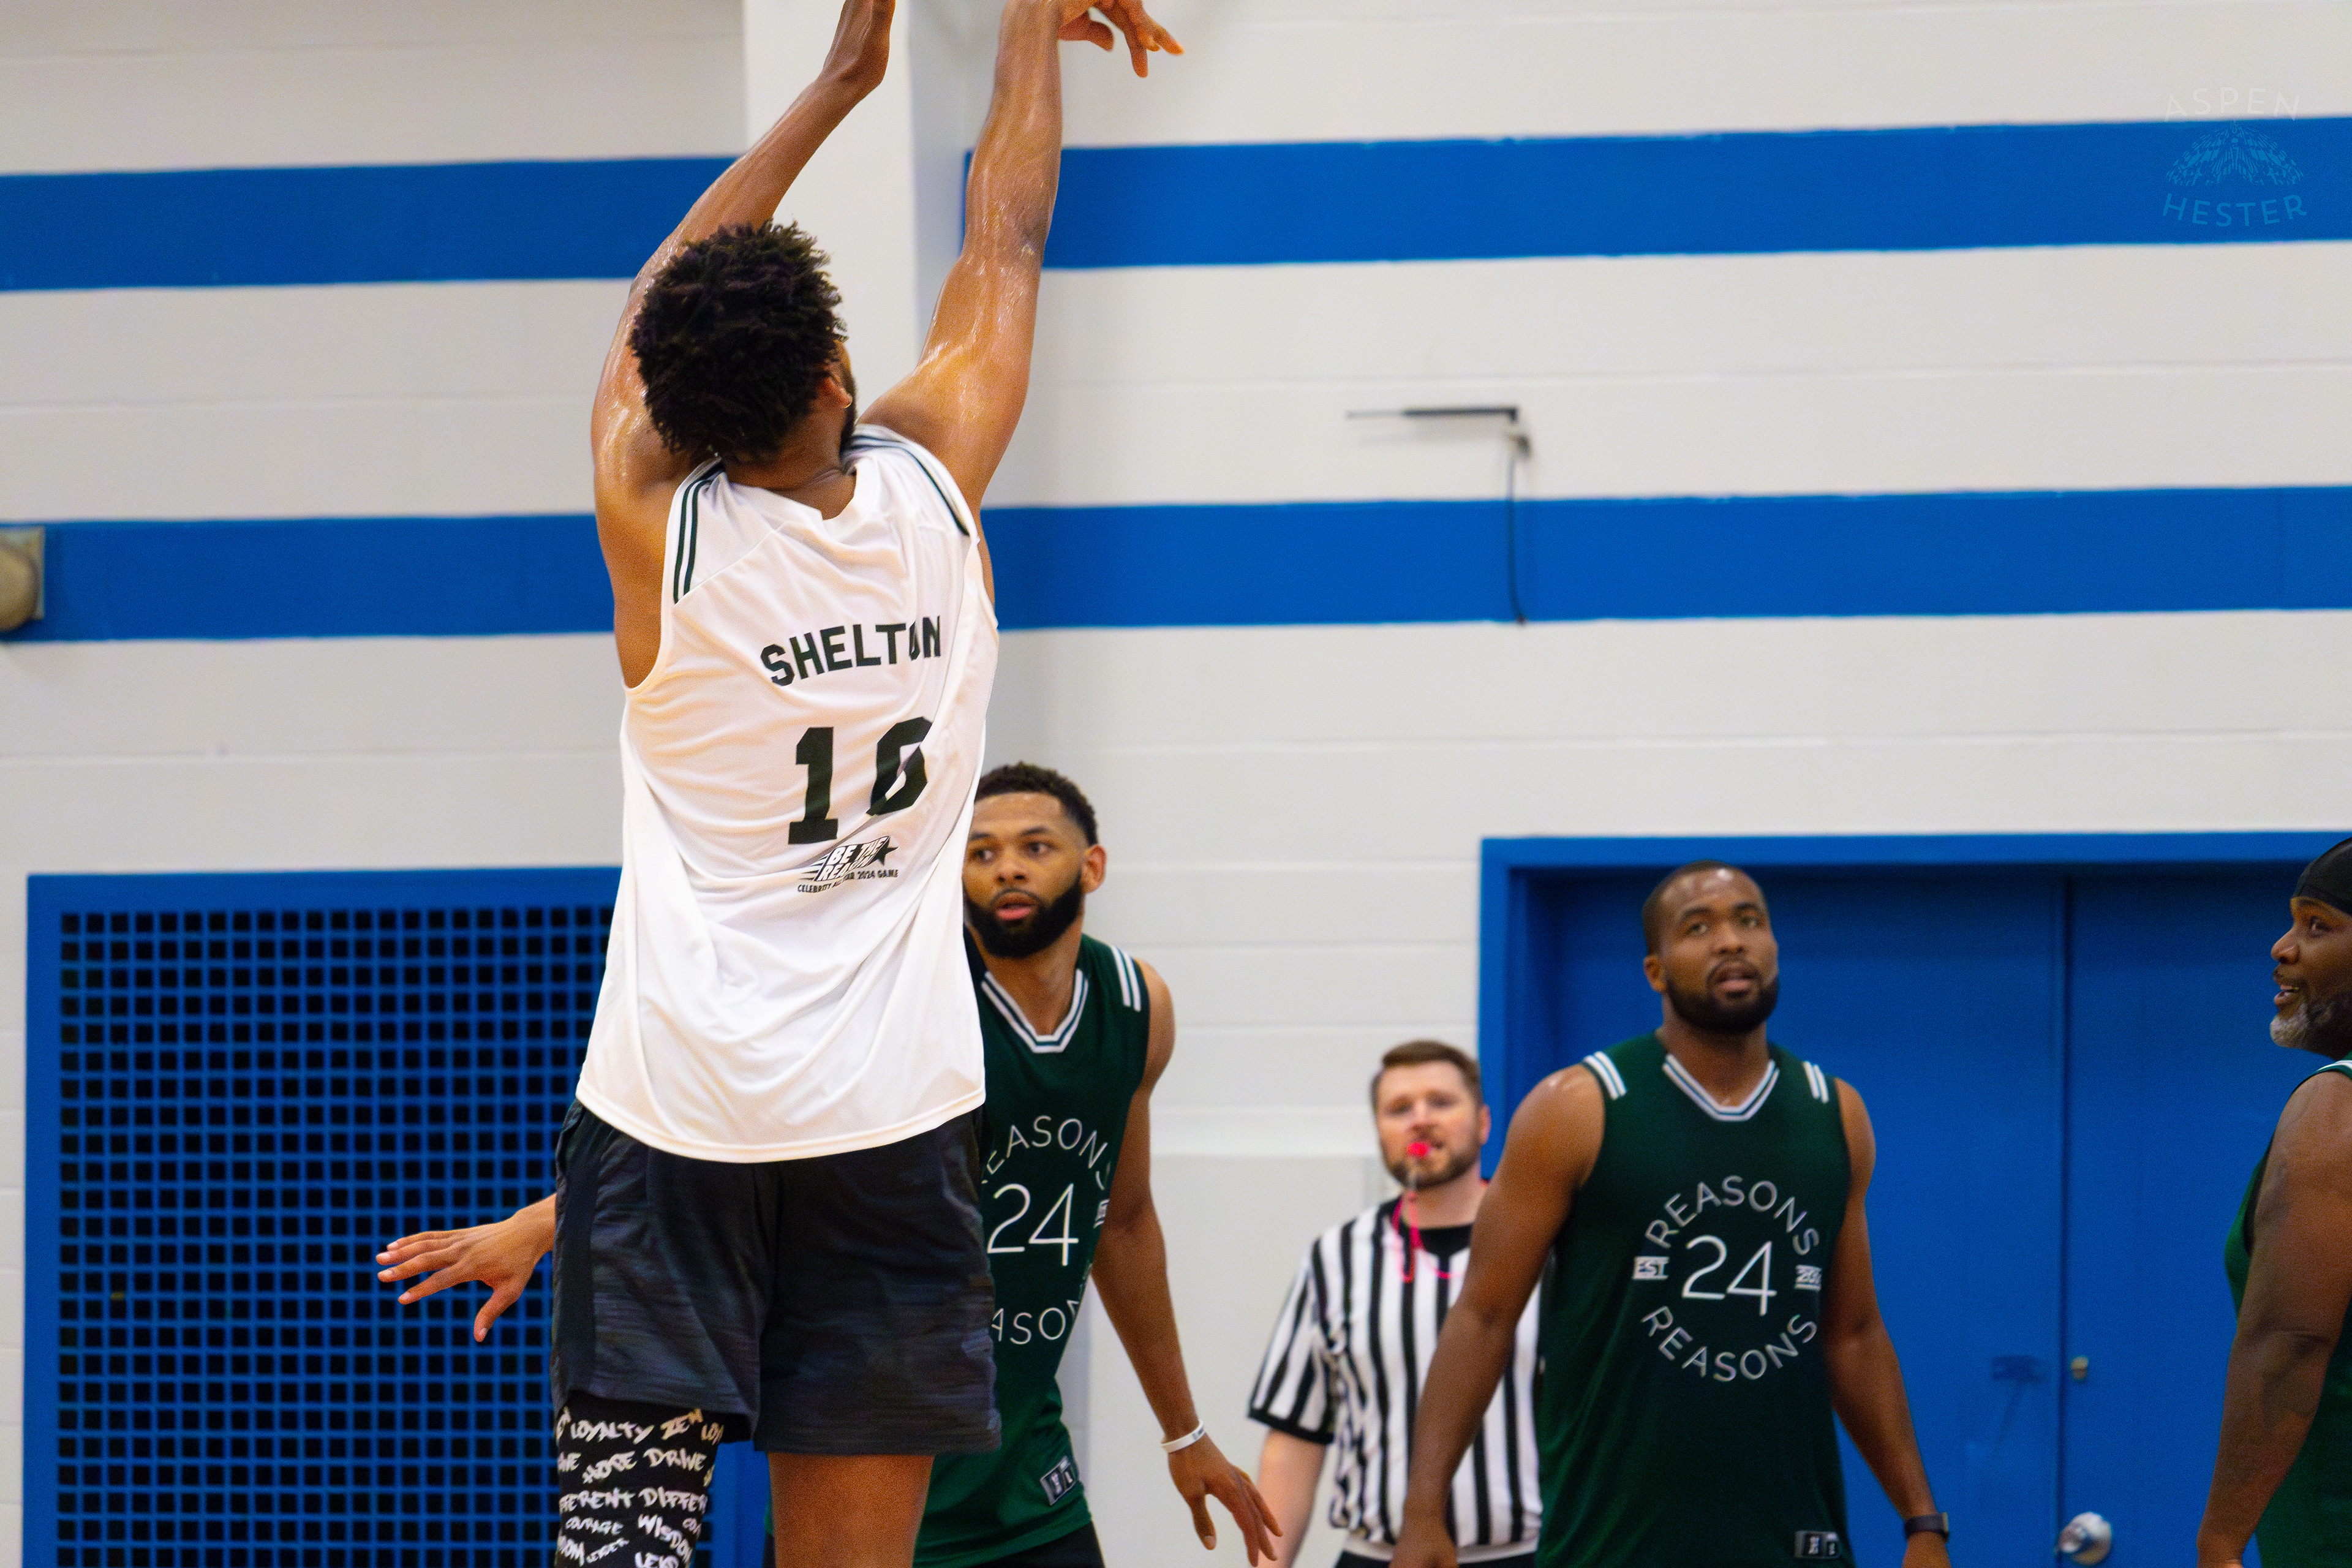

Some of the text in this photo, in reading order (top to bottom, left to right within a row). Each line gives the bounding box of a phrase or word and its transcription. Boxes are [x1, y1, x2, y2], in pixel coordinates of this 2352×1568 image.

[826, 837, 888, 865] BE THE
[987, 1183, 1079, 1266] 24
[1645, 1175, 1819, 1255] REASONS
[1682, 1235, 1777, 1316] 24
[1641, 1306, 1817, 1382] REASONS
[570, 1419, 654, 1445] LOYALTY
[643, 1447, 707, 1472] DRIVE
